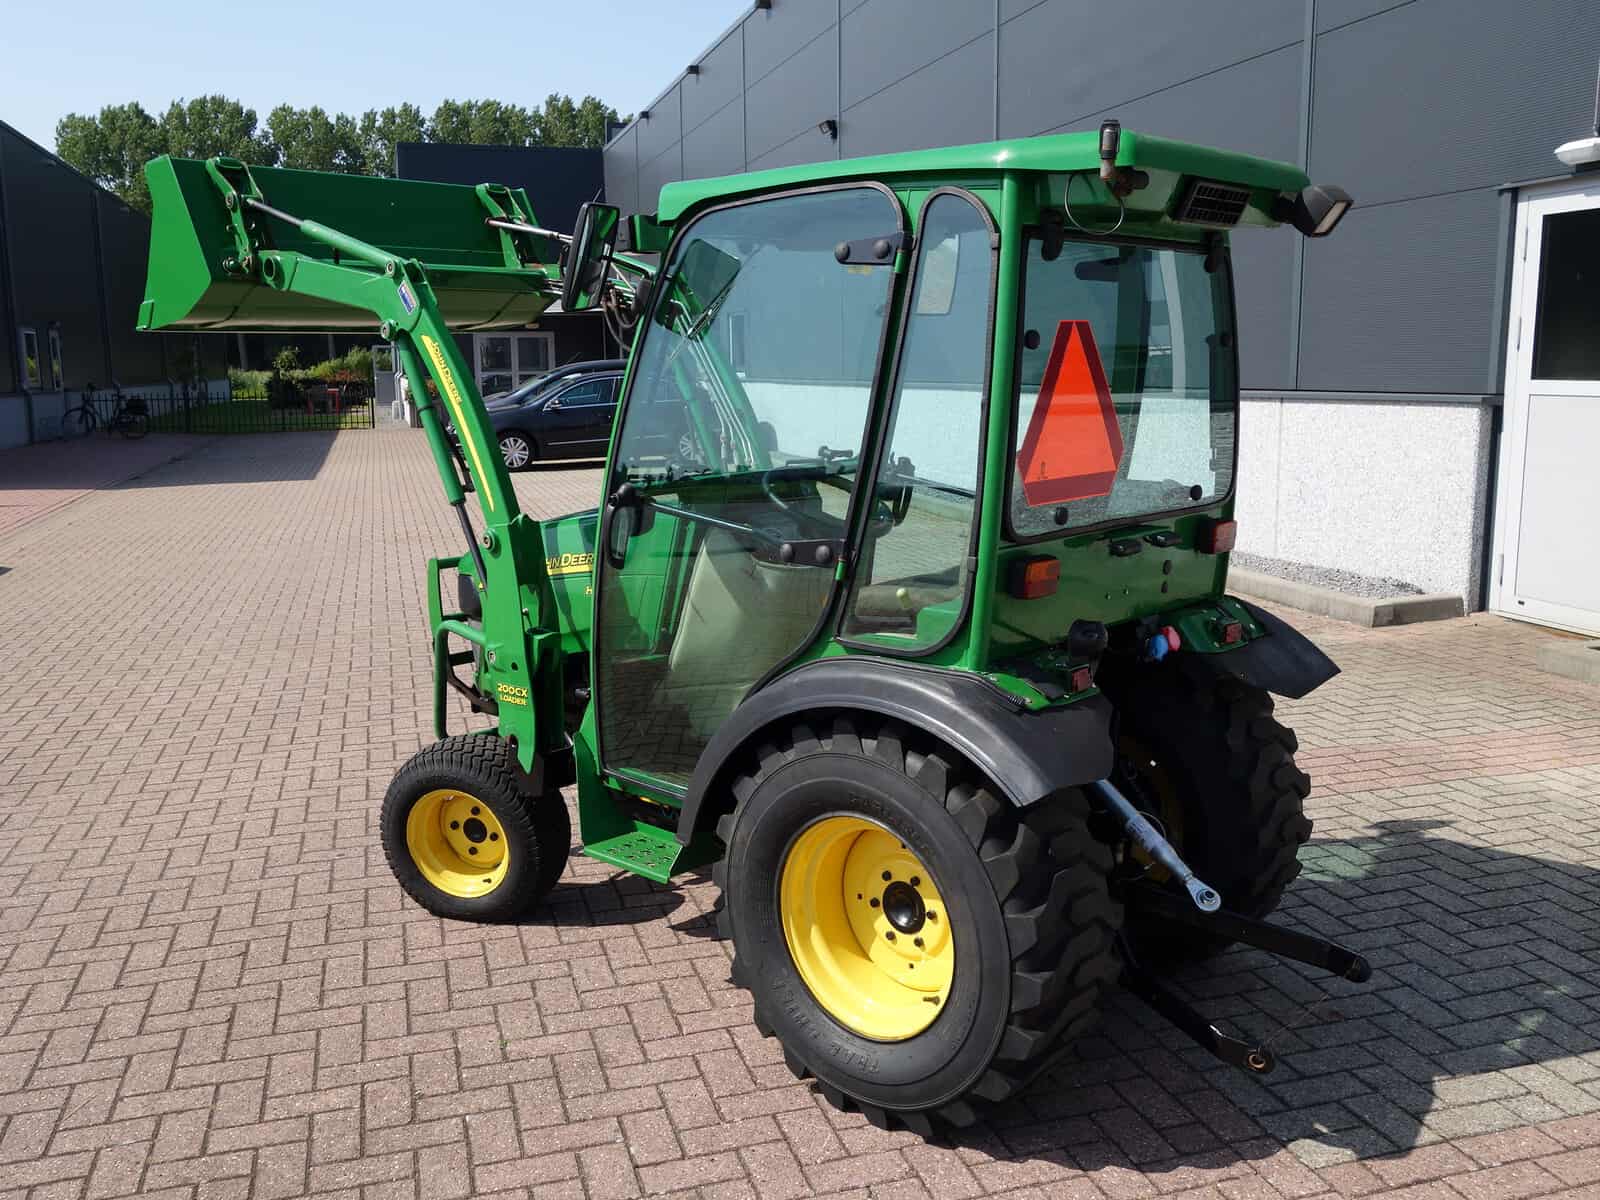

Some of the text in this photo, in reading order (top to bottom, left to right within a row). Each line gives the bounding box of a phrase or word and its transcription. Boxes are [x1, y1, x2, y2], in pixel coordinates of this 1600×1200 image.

[546, 553, 593, 569] HN DEER
[497, 683, 528, 698] 200CX
[499, 693, 527, 706] LOADER
